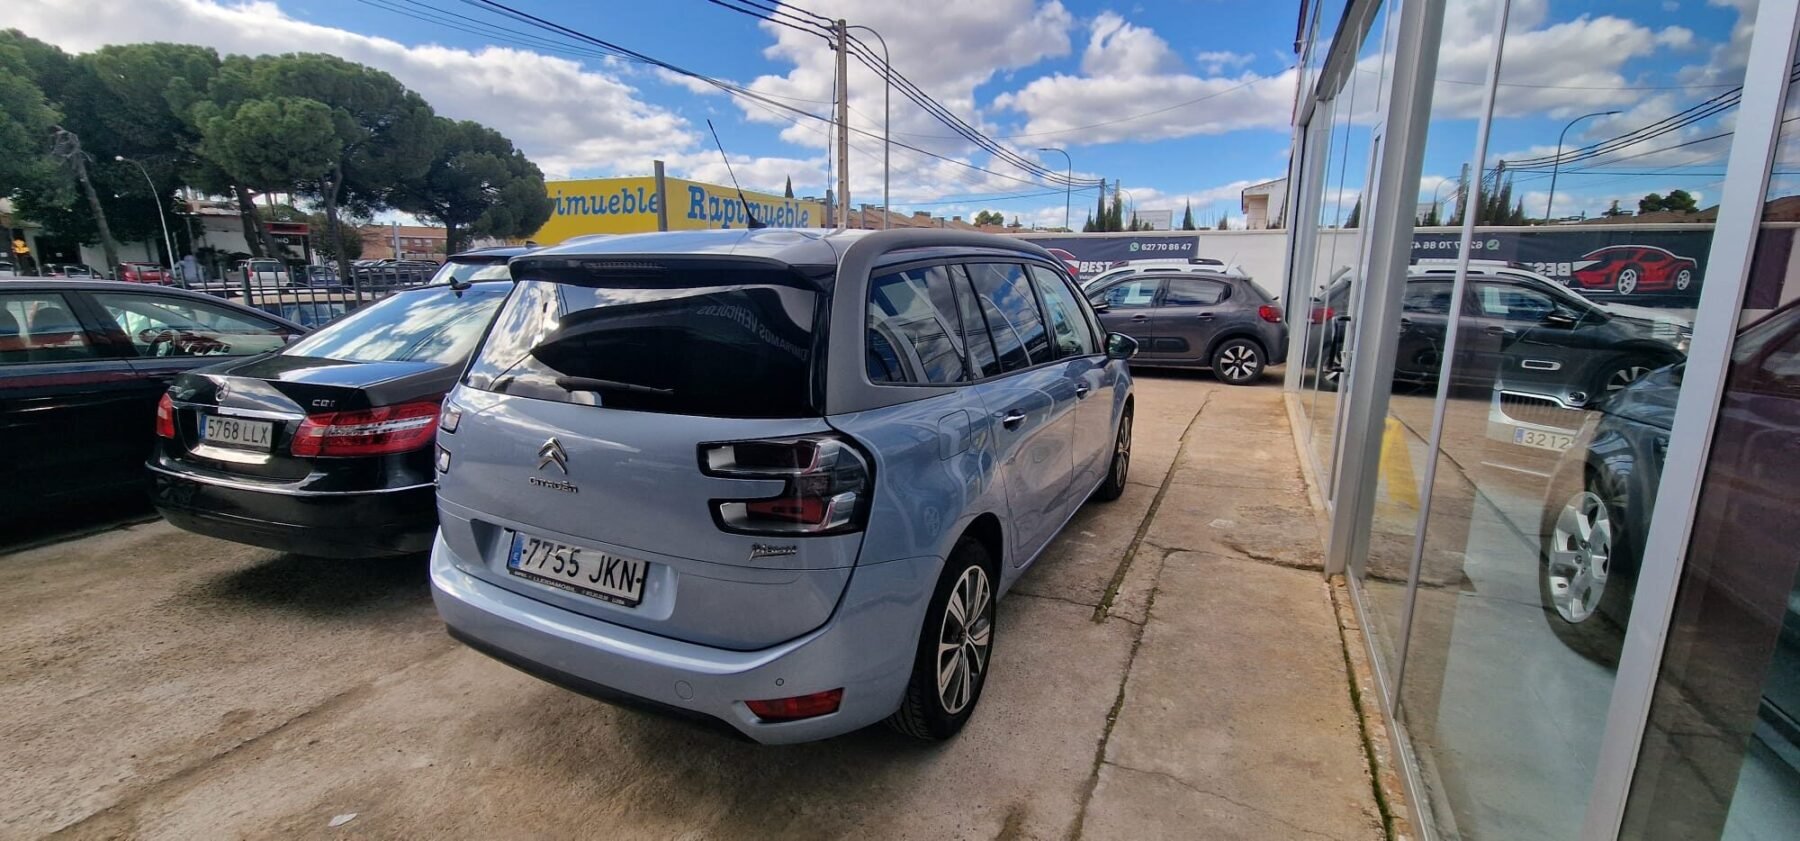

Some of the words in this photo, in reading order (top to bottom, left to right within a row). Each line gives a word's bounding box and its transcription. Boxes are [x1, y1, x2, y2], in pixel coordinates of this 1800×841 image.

[556, 187, 659, 216] imueble
[687, 185, 809, 230] Rapimueble
[1141, 243, 1156, 251] 627
[1157, 243, 1167, 251] 70
[1181, 243, 1192, 251] 47
[1080, 261, 1113, 273] BEST
[208, 419, 239, 440] 5768
[243, 423, 268, 444] LLX
[1525, 432, 1570, 449] 3212
[525, 538, 581, 577] 7755
[588, 554, 637, 592] JKN
